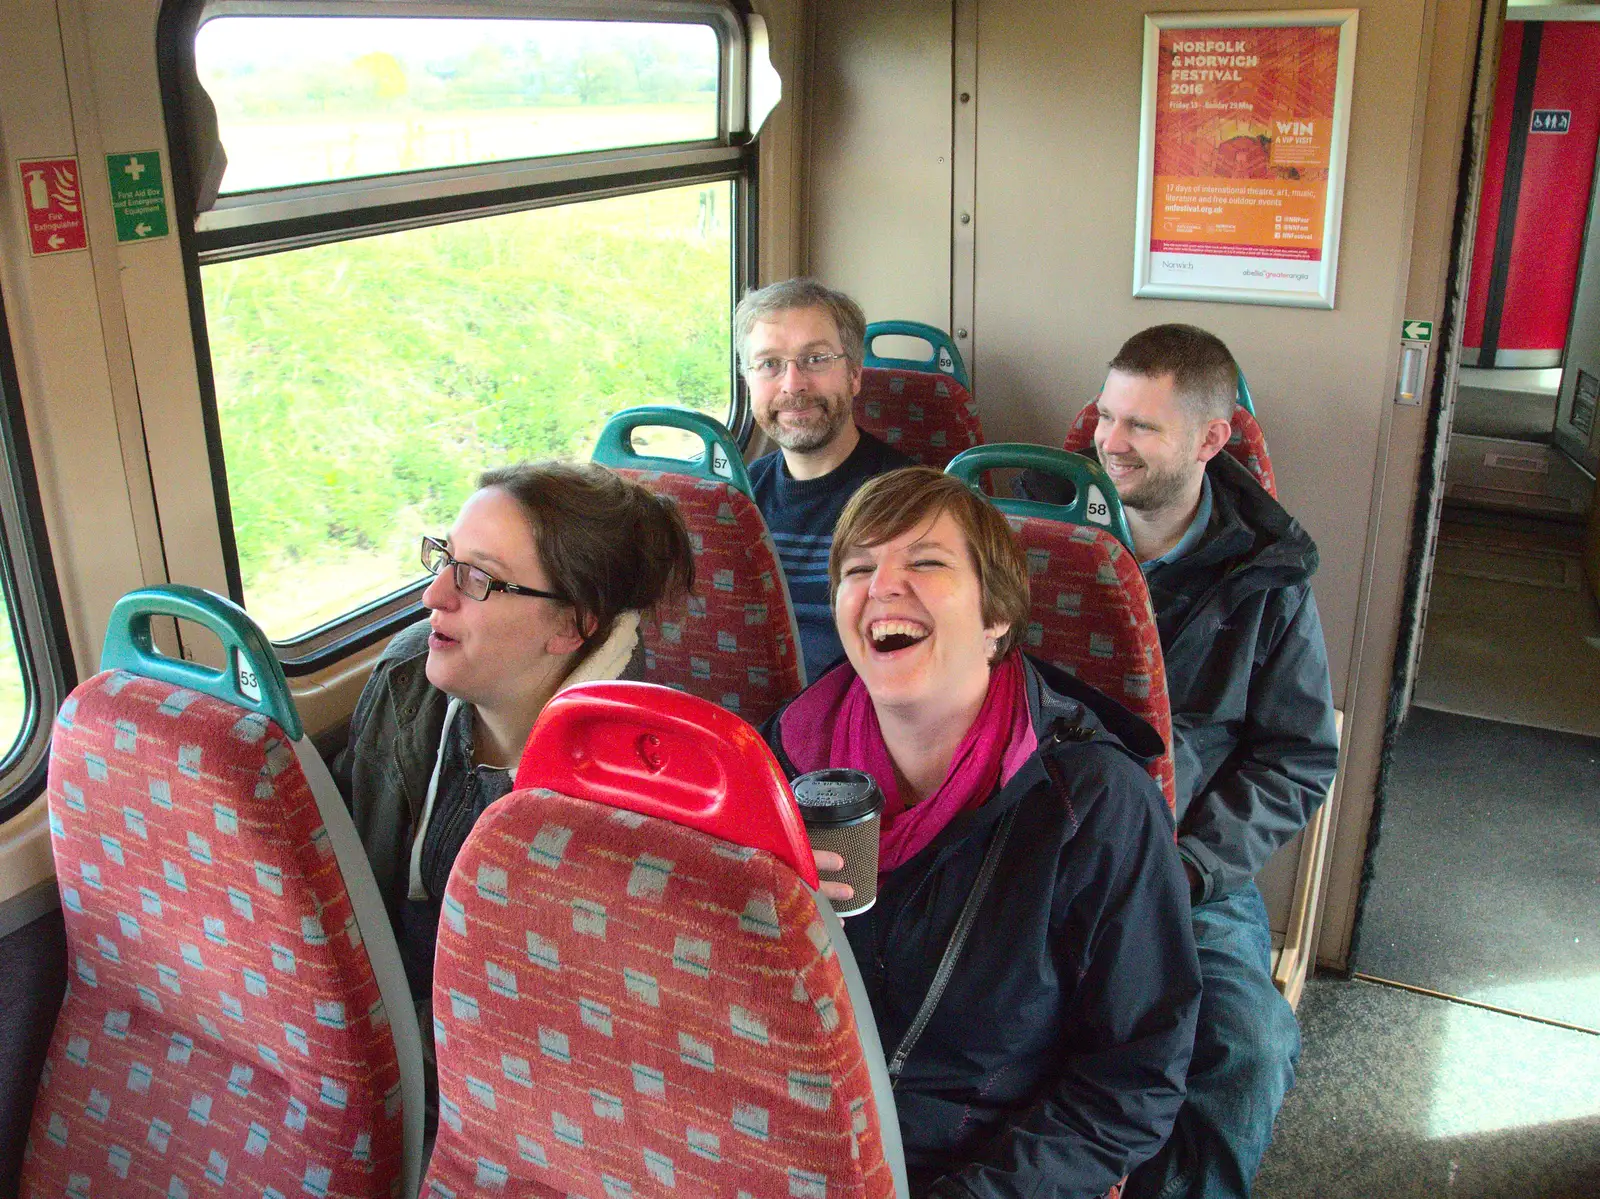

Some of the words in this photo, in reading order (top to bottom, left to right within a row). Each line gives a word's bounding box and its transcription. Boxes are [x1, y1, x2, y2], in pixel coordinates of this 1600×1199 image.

[1173, 41, 1245, 53] NORFOLK
[1171, 56, 1182, 67] &
[1184, 56, 1258, 68] NORWICH
[1171, 69, 1242, 81] FESTIVAL
[1170, 84, 1204, 95] 2016
[1275, 121, 1313, 136] WIN
[1295, 136, 1313, 144] VISIT
[118, 190, 133, 199] First
[134, 189, 146, 197] Aid
[147, 188, 161, 196] Box
[1166, 184, 1174, 192] 17
[1175, 185, 1192, 194] days
[1193, 185, 1201, 193] of
[1202, 186, 1247, 195] international
[1248, 187, 1275, 197] theatre,
[1277, 188, 1290, 197] art,
[1292, 190, 1316, 199] music,
[128, 198, 164, 207] Emergency
[1165, 193, 1197, 202] literature
[1198, 195, 1212, 203] and
[1213, 196, 1228, 204] free
[1229, 197, 1257, 205] outdoor
[124, 205, 160, 216] Equipment
[1164, 204, 1224, 215] nnfestival.org.uk
[47, 212, 64, 221] Fire
[34, 221, 79, 231] Extinguisher
[1162, 260, 1194, 270] Norwich
[940, 358, 952, 367] 59
[714, 458, 728, 469] 57
[1088, 503, 1107, 516] 58
[240, 671, 258, 688] 53
